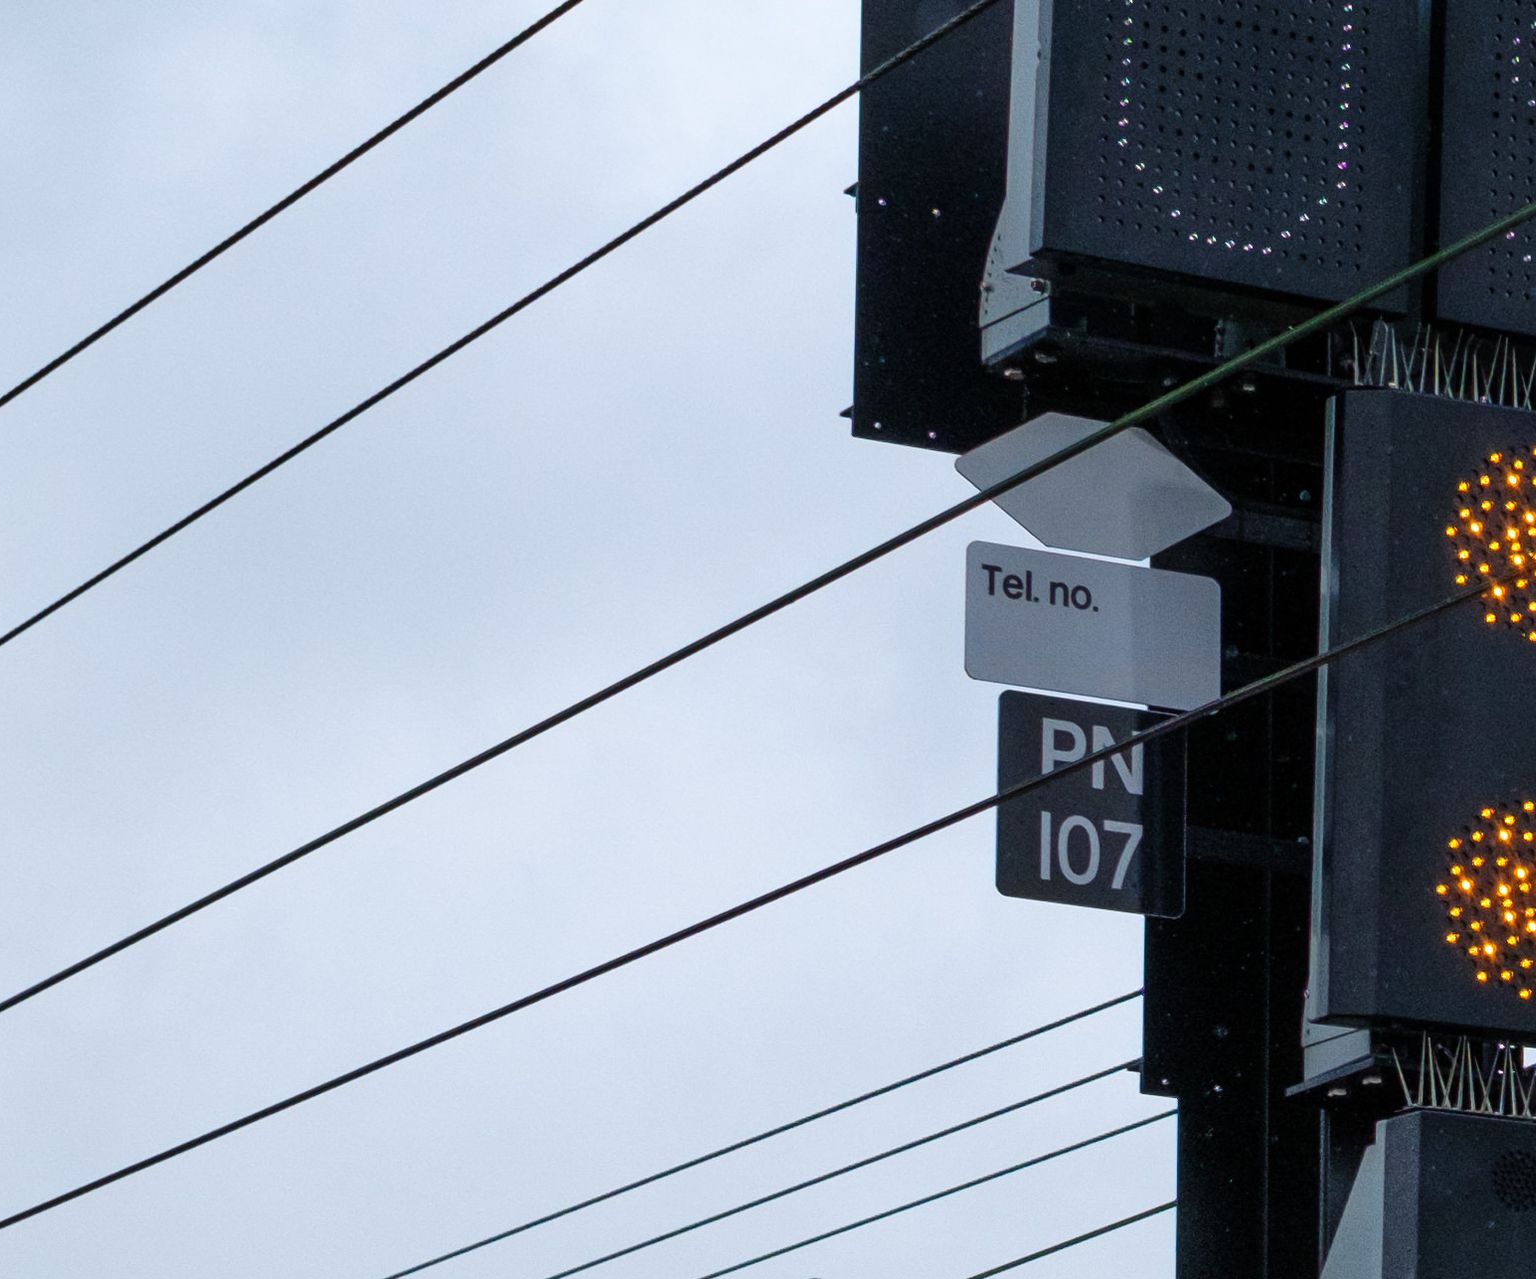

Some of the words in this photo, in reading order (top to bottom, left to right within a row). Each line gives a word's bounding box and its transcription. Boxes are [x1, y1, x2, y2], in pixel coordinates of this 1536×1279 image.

[981, 563, 1040, 602] Tel.
[1048, 580, 1099, 612] no.
[1041, 717, 1144, 795] PN
[1039, 810, 1143, 890] 107
